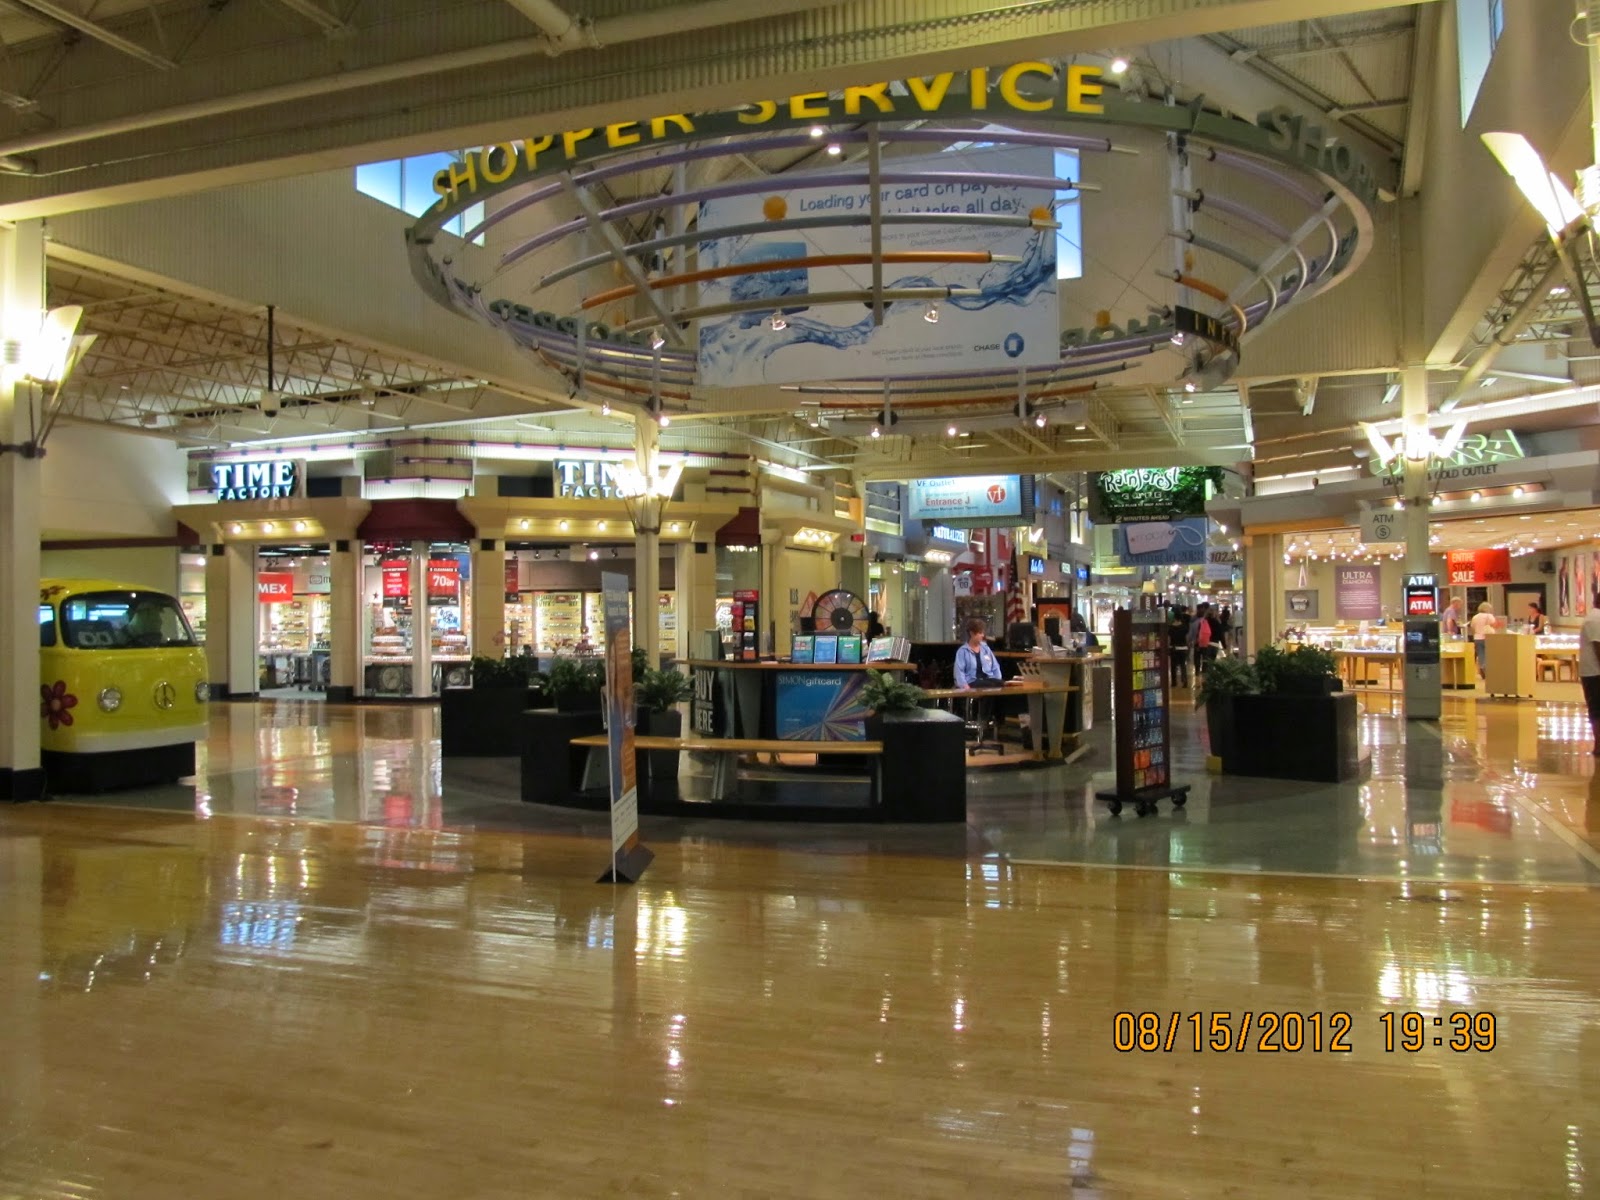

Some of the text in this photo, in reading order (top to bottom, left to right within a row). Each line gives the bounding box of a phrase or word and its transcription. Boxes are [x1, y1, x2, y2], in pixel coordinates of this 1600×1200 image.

[738, 62, 1104, 124] SERVICE
[800, 194, 854, 212] Loading
[895, 184, 929, 200] card
[966, 198, 984, 213] all
[973, 343, 1000, 352] CHASE
[214, 460, 294, 488] TIME
[1434, 468, 1459, 480] GOLD
[1462, 464, 1498, 476] OUTLET
[1101, 467, 1181, 492] Rainforest
[217, 485, 292, 500] FACTORY
[562, 485, 626, 499] FACTO
[926, 497, 963, 507] Entrance
[1115, 515, 1122, 523] 2
[1373, 513, 1394, 523] ATM
[1451, 552, 1475, 562] ENTIRE
[1452, 562, 1475, 571] STORE
[1342, 571, 1373, 580] ULTRA
[1408, 576, 1433, 586] ATM
[1451, 571, 1475, 583] SALE
[257, 583, 287, 594] MEX
[1409, 601, 1433, 610] ATM
